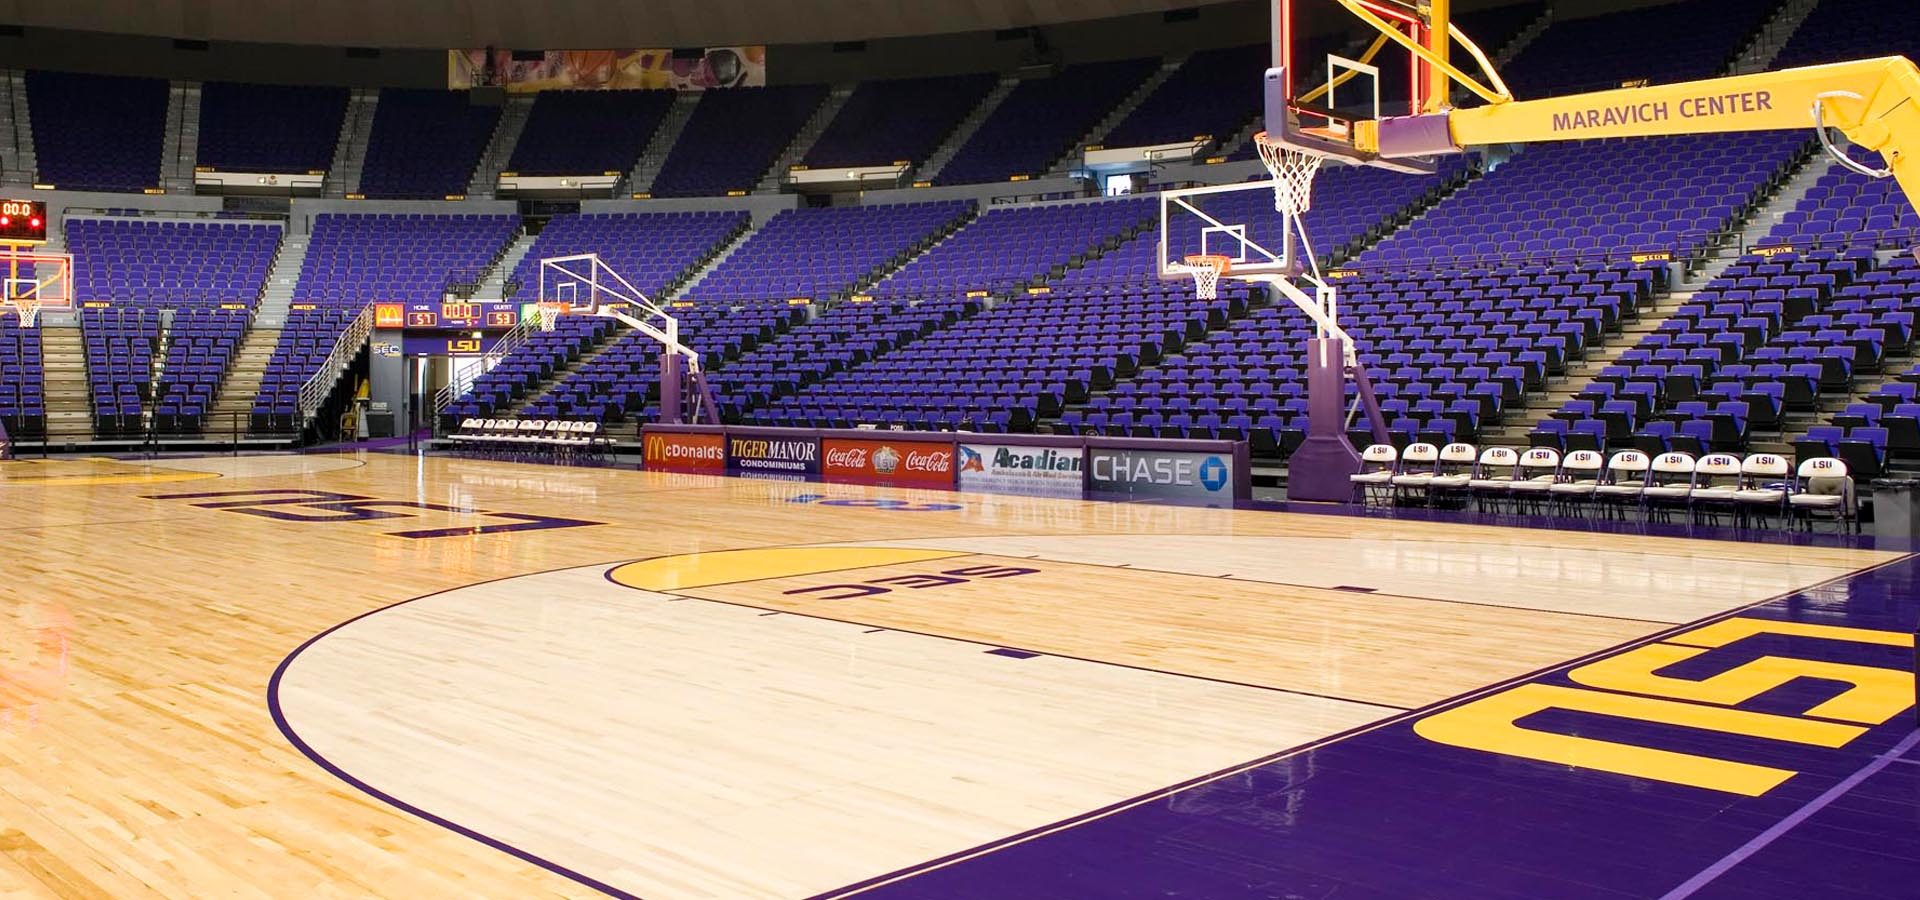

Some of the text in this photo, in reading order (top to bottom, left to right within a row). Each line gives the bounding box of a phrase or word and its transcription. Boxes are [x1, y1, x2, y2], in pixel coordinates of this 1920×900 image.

[1553, 91, 1772, 131] MARAVICH CENTER
[416, 314, 431, 325] 57
[496, 314, 510, 325] 53
[373, 345, 400, 354] SEC
[448, 340, 480, 352] LSU
[647, 436, 724, 461] McDonald's
[1491, 450, 1507, 458] LSU
[992, 447, 1082, 471] Acadian
[1530, 451, 1549, 459] LSU
[1575, 453, 1591, 461] LSU
[1621, 454, 1638, 462] LSU
[1665, 456, 1682, 464] LSU
[1756, 456, 1775, 465] LSU
[740, 459, 805, 470] CONDOMINIUMS
[1707, 457, 1730, 466] LSU
[1812, 460, 1832, 469] LSU
[1093, 455, 1193, 485] CHASE
[783, 565, 1041, 600] SEC
[1413, 617, 1916, 797] LSU
